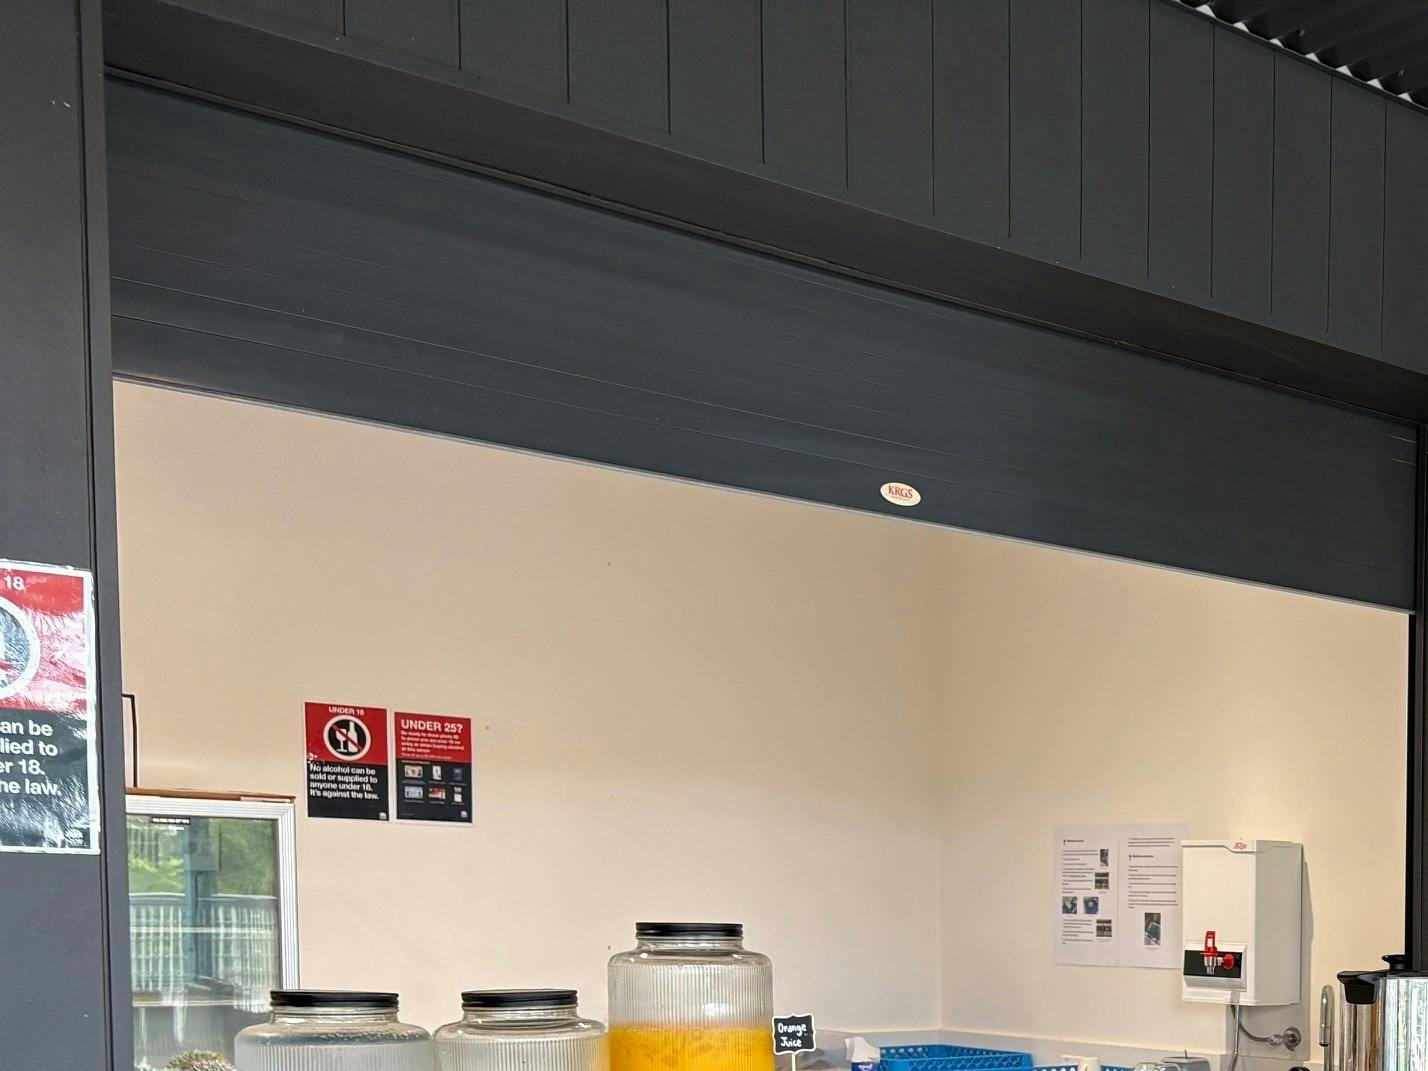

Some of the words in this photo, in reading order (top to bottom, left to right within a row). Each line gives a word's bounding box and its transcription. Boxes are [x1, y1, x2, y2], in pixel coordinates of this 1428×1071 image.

[888, 485, 913, 499] KRGS
[4, 575, 26, 592] 18
[328, 706, 355, 715] UNDER
[0, 720, 24, 735] an
[28, 720, 53, 736] be
[401, 719, 442, 732] UNDER
[443, 722, 464, 734] 25?
[0, 738, 34, 755] lied
[39, 741, 58, 756] to
[18, 760, 46, 775] 18.
[310, 763, 321, 772] No
[322, 765, 350, 774] alcohol
[350, 766, 365, 775] can
[366, 767, 376, 775] be
[309, 772, 326, 780] sold
[337, 774, 369, 784] supplied
[370, 775, 378, 784] to
[25, 779, 62, 796] law.
[309, 781, 338, 790] anyone
[338, 782, 360, 790] under
[322, 790, 350, 798] against
[350, 791, 364, 799] the
[364, 791, 380, 800] law.
[778, 1022, 807, 1037] Orange
[780, 1036, 802, 1047] Juice
